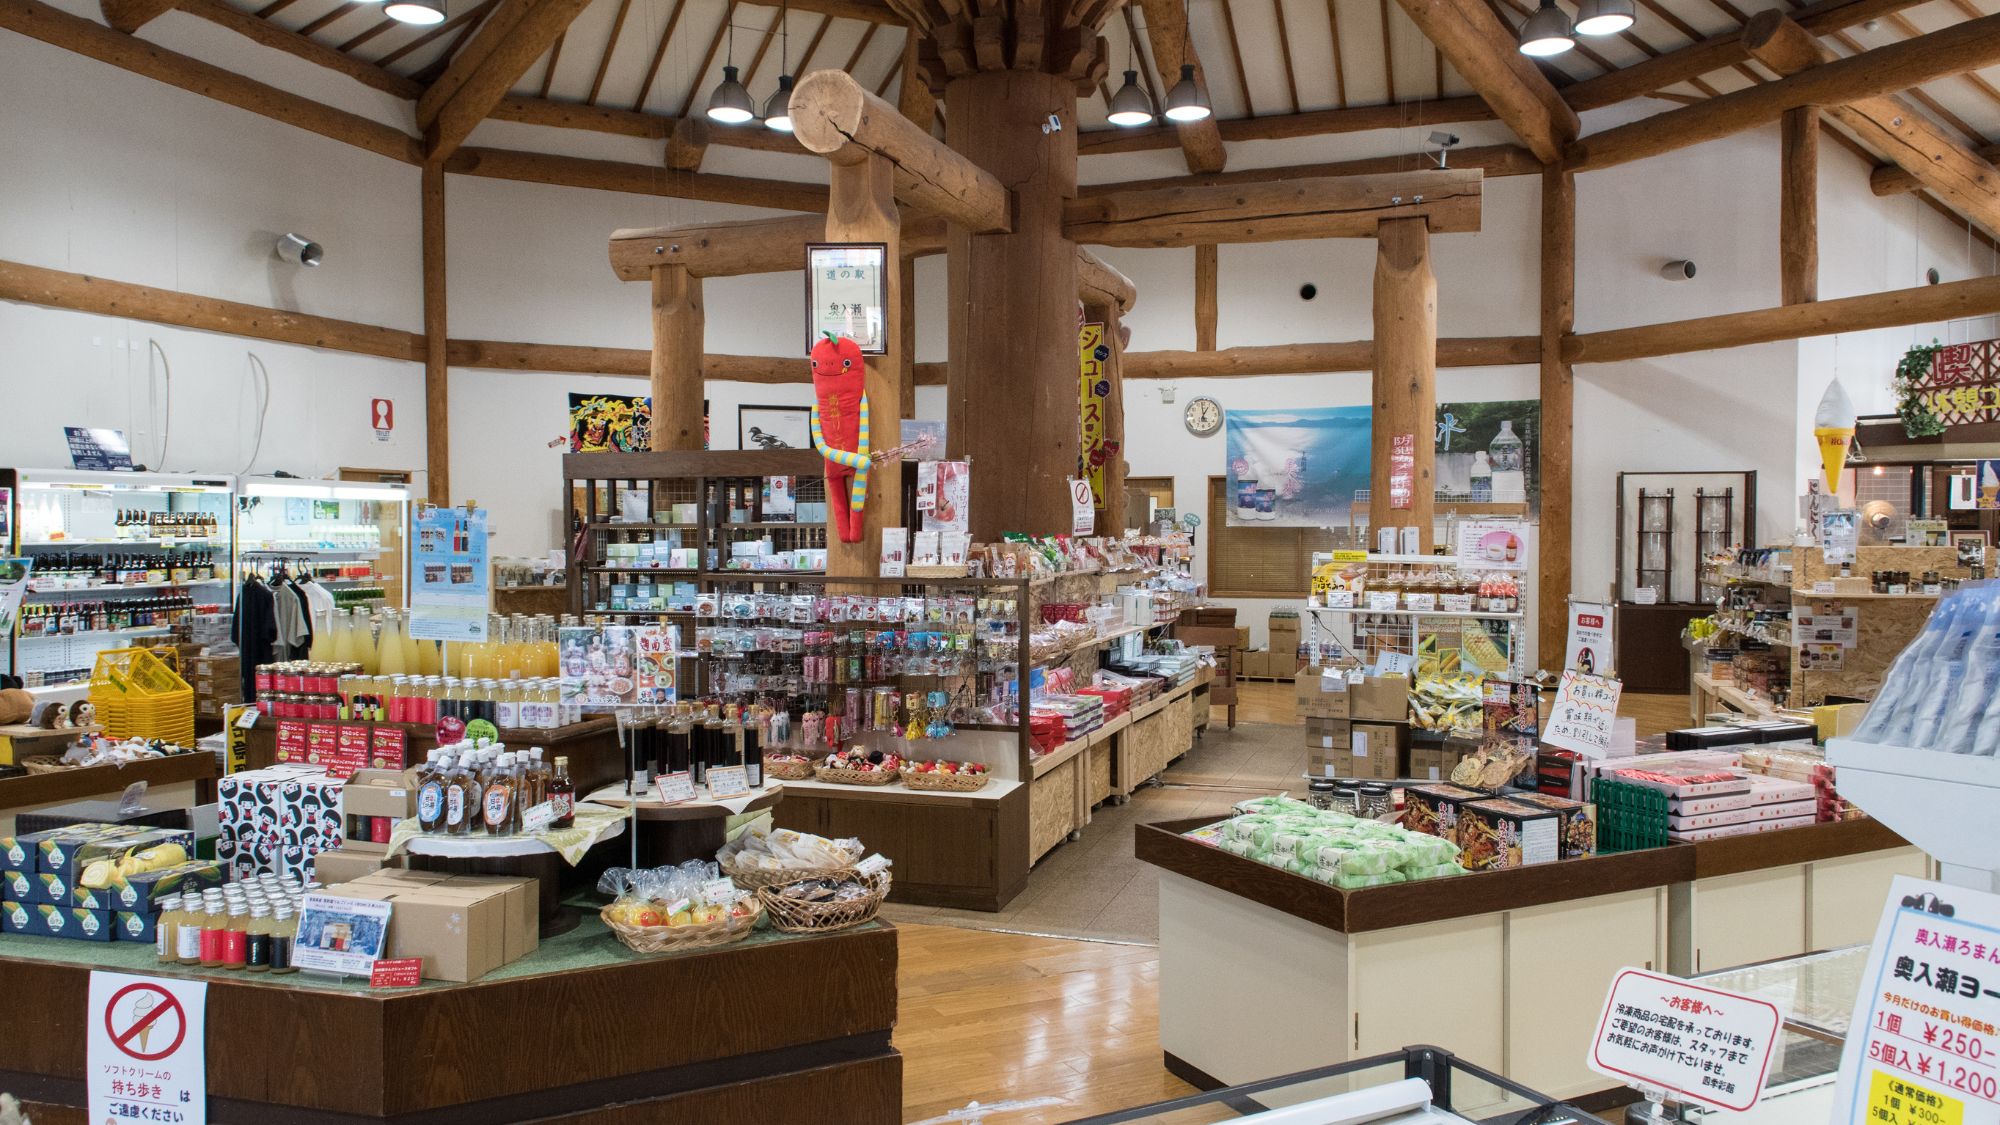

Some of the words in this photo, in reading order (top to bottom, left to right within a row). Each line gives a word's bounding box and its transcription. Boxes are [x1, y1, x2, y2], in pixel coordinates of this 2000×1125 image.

[826, 268, 866, 281] 道の駅
[1615, 1003, 1756, 1051] 冷凍商品の宅配を承っております。
[1611, 1018, 1749, 1065] ご要望のお客様は、スタッフまで
[1606, 1032, 1727, 1077] お気軽にお声がけ下さいませ。
[104, 1063, 172, 1081] ソフトクリームの
[112, 1079, 163, 1100] 持ち歩き
[179, 1089, 191, 1103] は
[108, 1102, 184, 1124] ご遠慮ください
